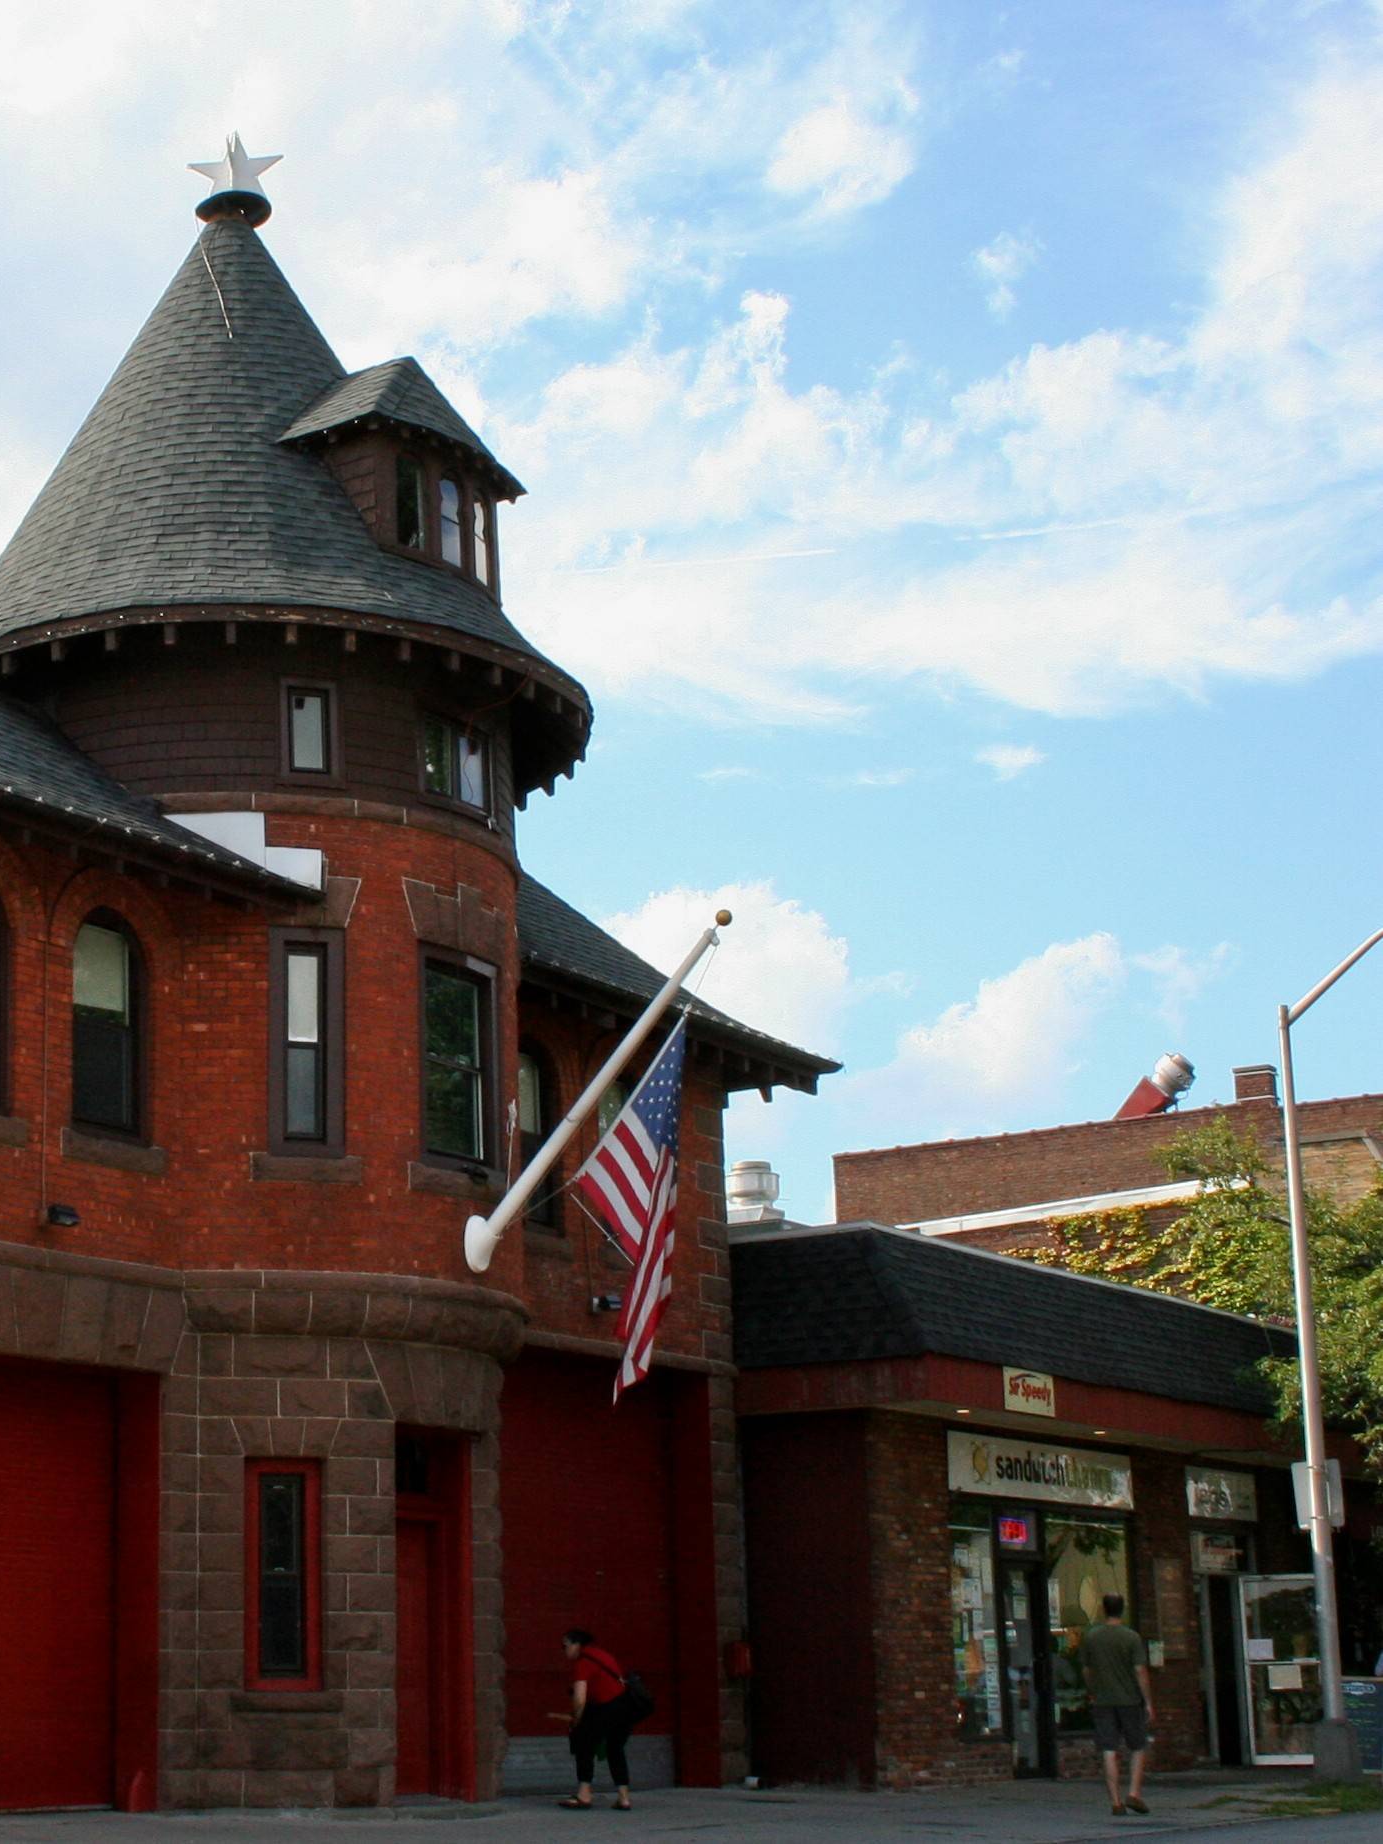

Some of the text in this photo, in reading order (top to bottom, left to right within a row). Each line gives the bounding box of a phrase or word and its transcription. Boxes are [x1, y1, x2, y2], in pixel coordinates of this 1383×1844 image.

[1008, 1376, 1051, 1408] Sir Speedy
[995, 1450, 1066, 1488] sandwich
